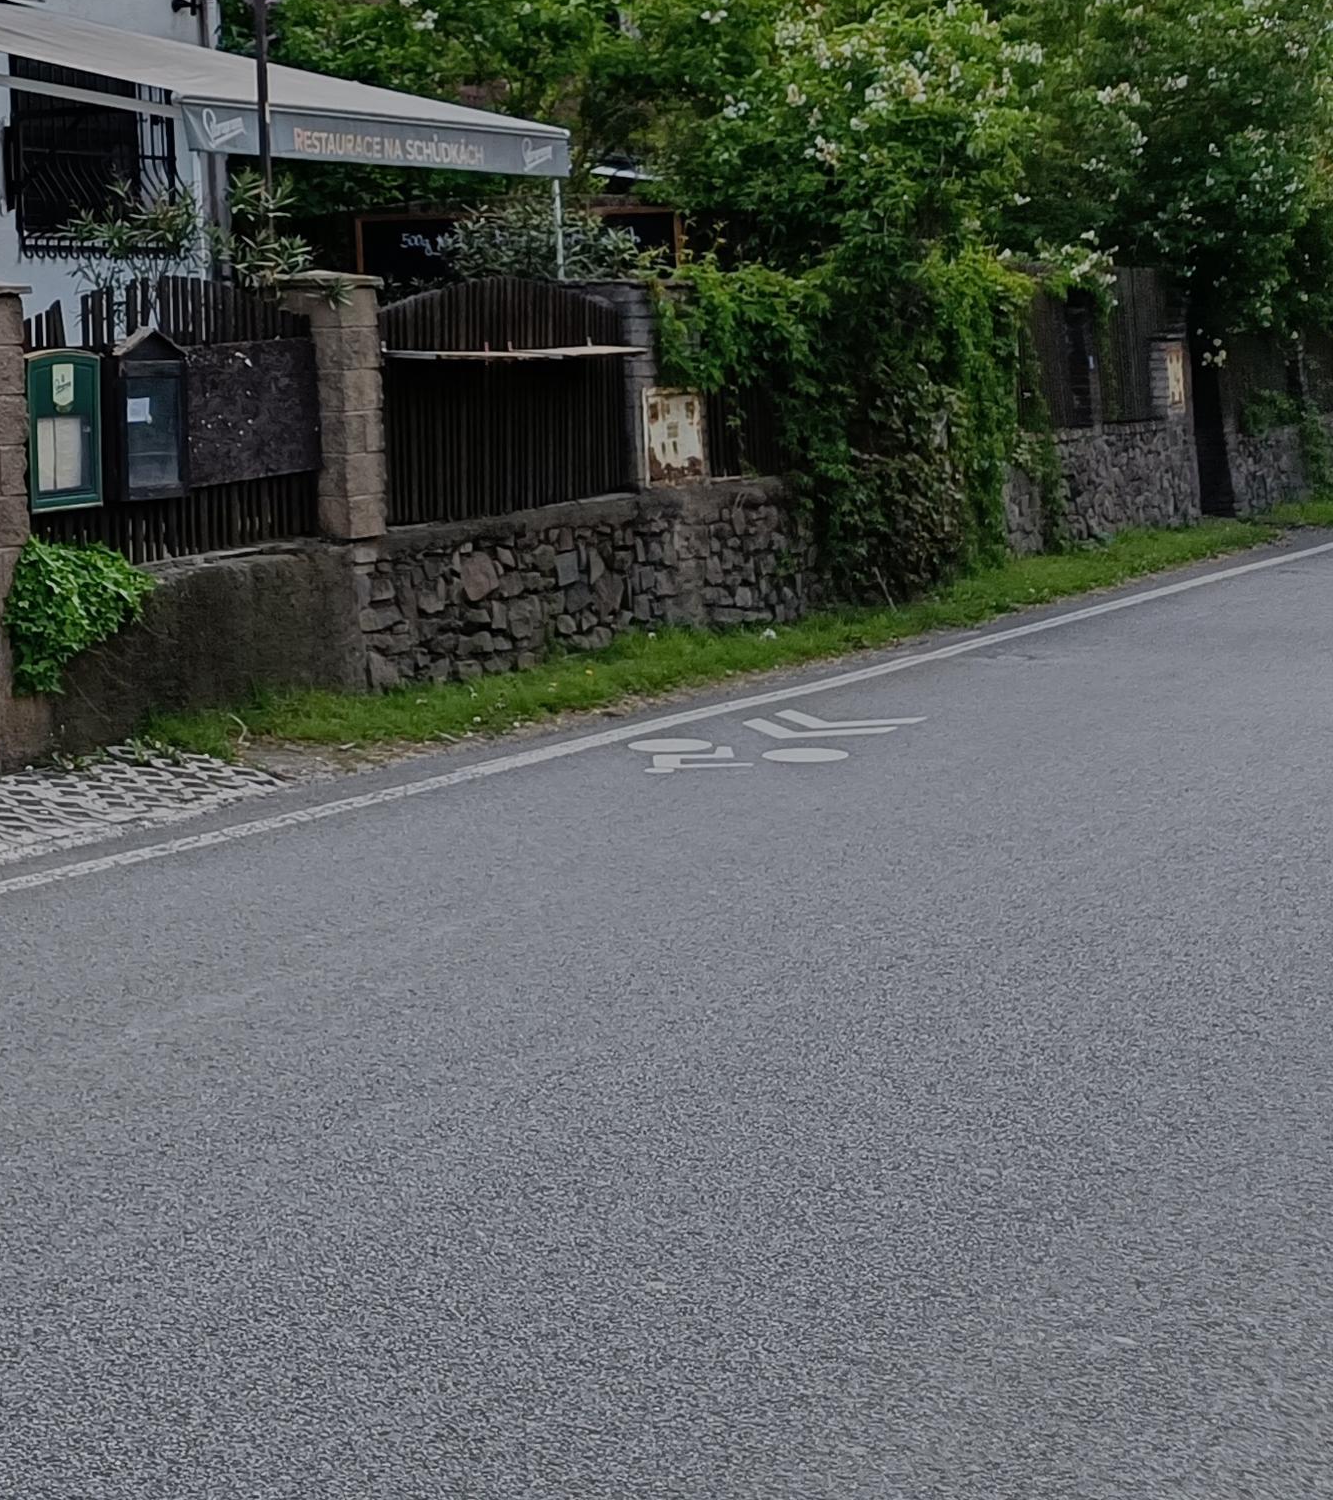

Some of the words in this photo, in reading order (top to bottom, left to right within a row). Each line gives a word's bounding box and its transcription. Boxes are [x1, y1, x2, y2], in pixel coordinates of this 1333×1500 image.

[294, 127, 382, 159] RESTAURACE
[384, 137, 404, 160] NA
[406, 132, 485, 167] SCHŮDKÁCH
